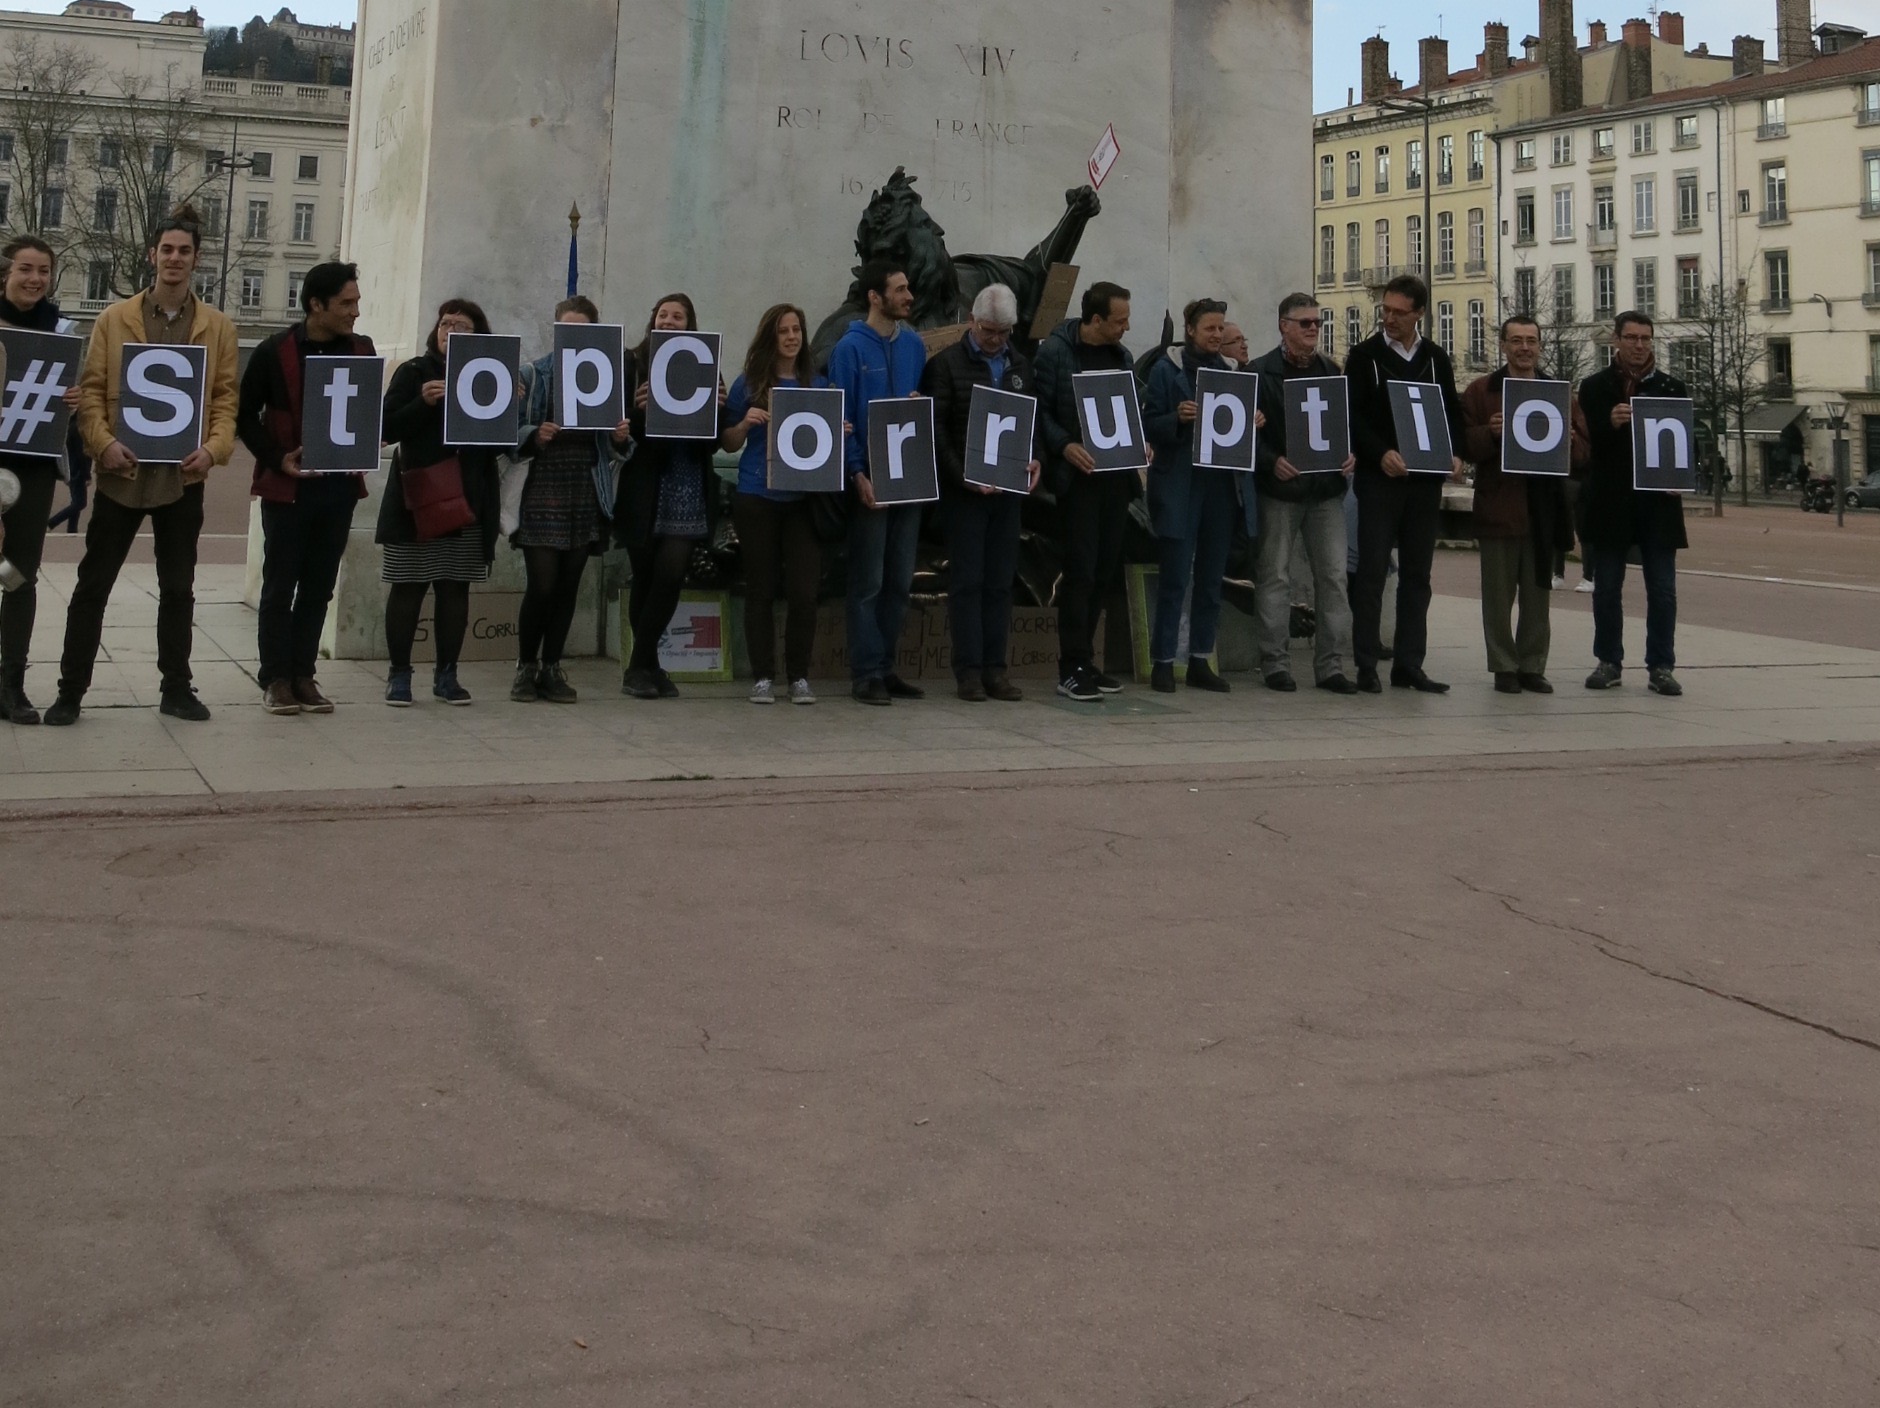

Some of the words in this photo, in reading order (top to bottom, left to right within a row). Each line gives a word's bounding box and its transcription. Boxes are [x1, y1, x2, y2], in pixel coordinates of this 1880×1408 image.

[800, 28, 914, 70] LOVIS
[955, 43, 1016, 78] XIV
[777, 105, 822, 130] ROI
[862, 112, 895, 135] DE
[935, 118, 1034, 146] FRANCE
